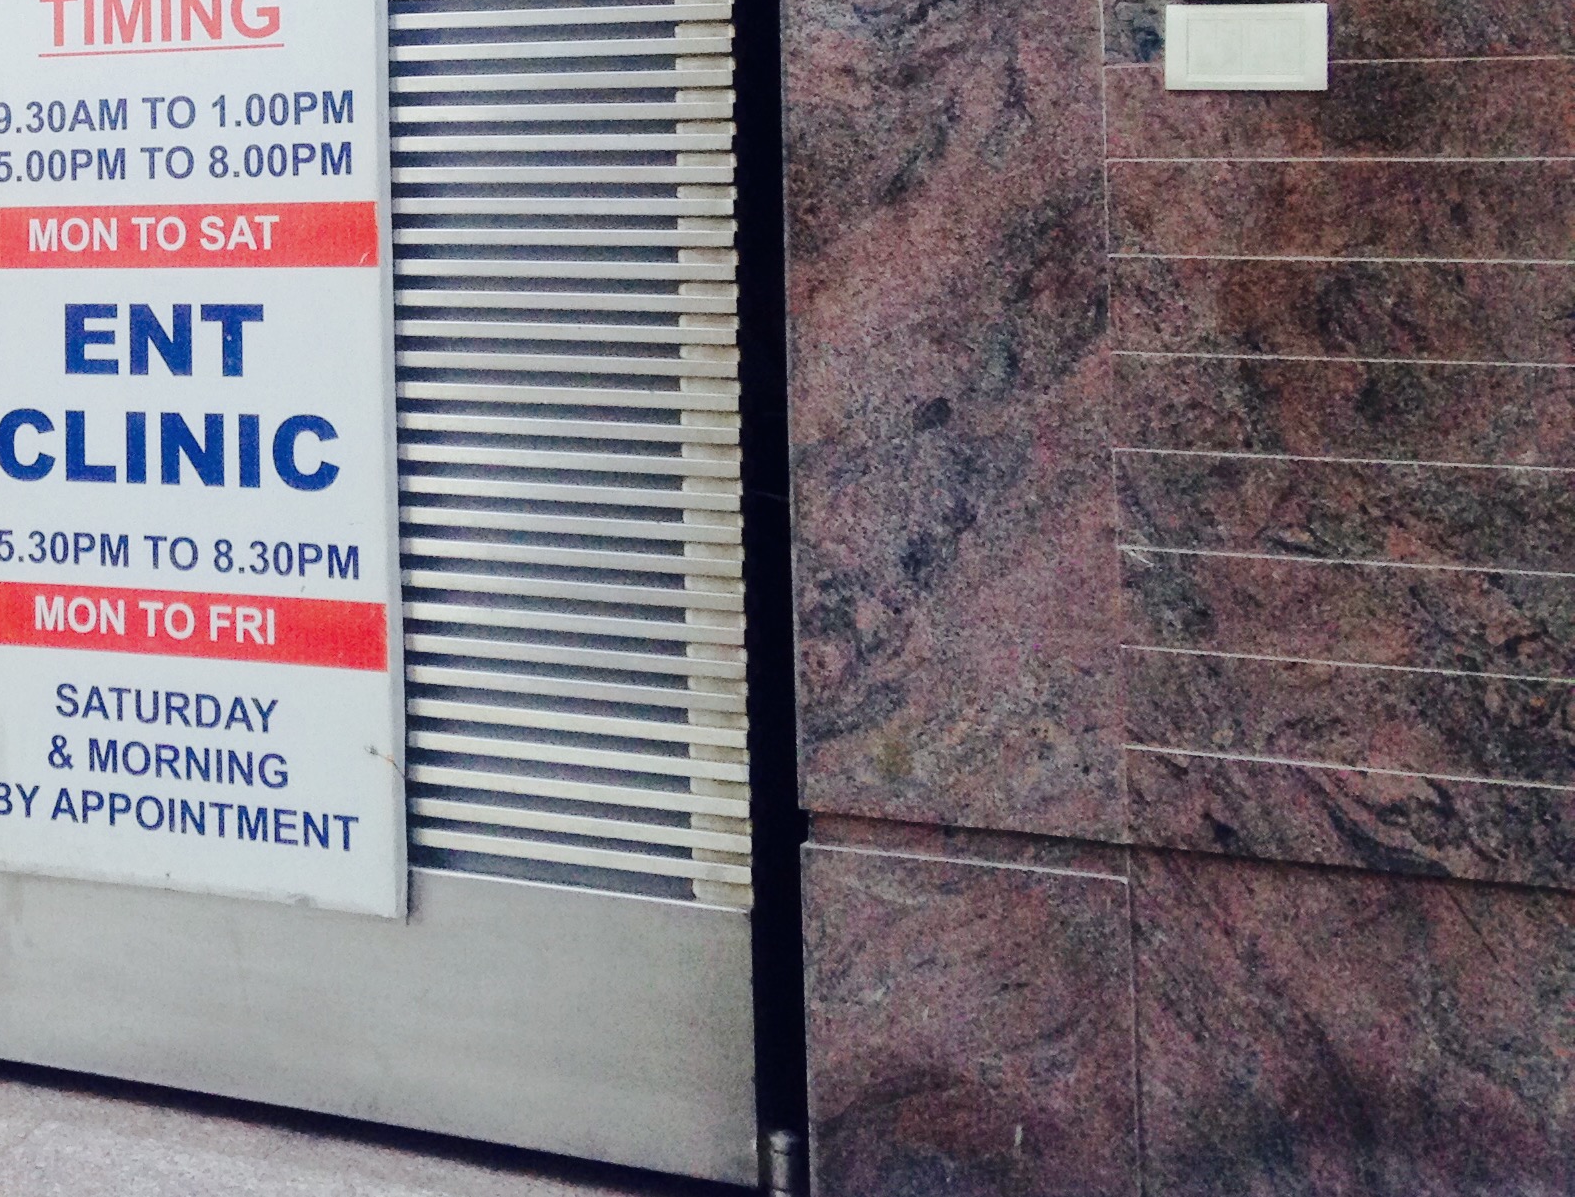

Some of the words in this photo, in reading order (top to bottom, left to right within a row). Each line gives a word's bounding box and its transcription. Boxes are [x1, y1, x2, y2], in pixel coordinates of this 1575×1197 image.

[142, 95, 196, 130] TO
[211, 90, 355, 127] 1.00PM
[140, 146, 194, 180] TO
[208, 142, 353, 178] 8.00PM
[28, 217, 118, 253] MON
[132, 216, 186, 252] TO
[200, 215, 279, 251] SAT
[64, 303, 264, 377] ENT
[144, 536, 198, 571] TO
[213, 539, 360, 580] 8.30PM
[34, 595, 125, 635] MON
[139, 601, 195, 640] TO
[209, 605, 275, 645] FRI
[55, 683, 278, 733] SATURDAY
[48, 735, 73, 770] &
[88, 738, 288, 790] MORNING
[50, 788, 359, 852] APPOINTMENT
